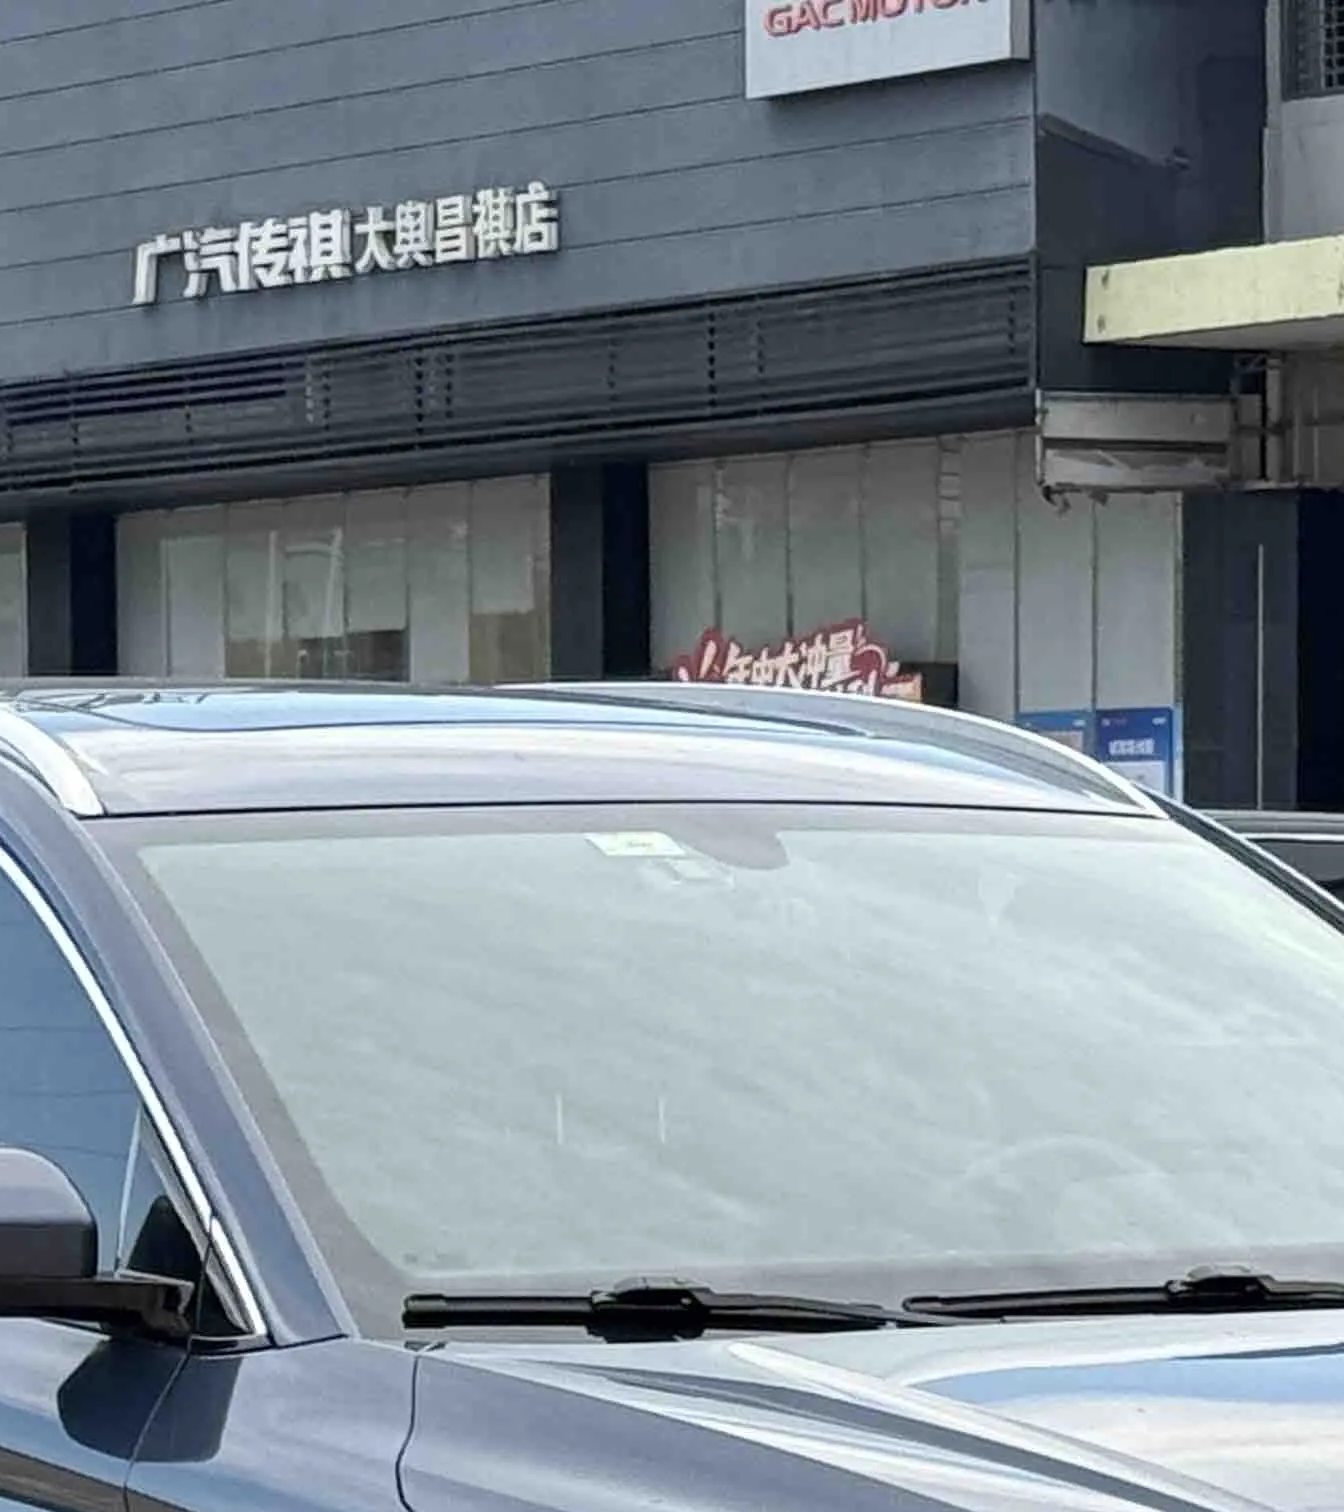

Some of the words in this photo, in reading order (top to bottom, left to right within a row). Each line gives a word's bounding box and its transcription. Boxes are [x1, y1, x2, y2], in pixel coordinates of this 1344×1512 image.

[764, 0, 844, 37] GAC
[133, 206, 354, 304] 广汽传祺
